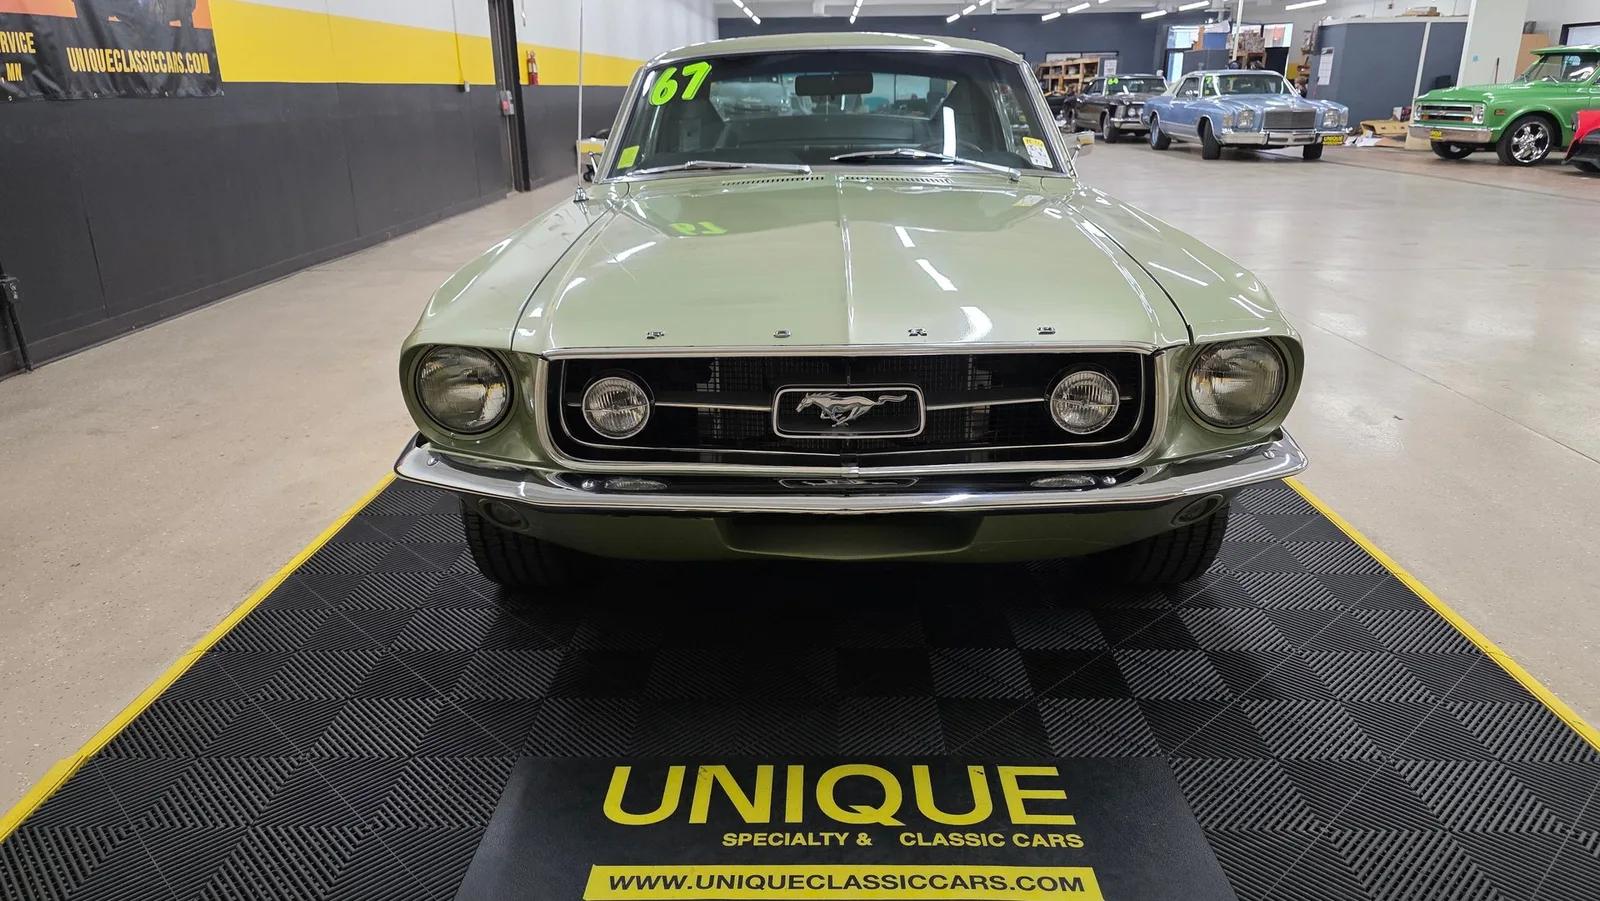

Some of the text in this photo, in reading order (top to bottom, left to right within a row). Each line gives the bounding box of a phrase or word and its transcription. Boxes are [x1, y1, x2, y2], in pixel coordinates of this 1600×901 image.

[0, 31, 36, 53] RVICE
[66, 47, 210, 74] UNIQUECLASSICCARS.COM
[648, 61, 712, 106] 67
[603, 763, 1077, 826] UNIQUE
[722, 832, 1085, 848] SPECIALTY & CLASSIC CARS
[609, 874, 1085, 892] WWW.UNIQUECLASSICCARS.COM
